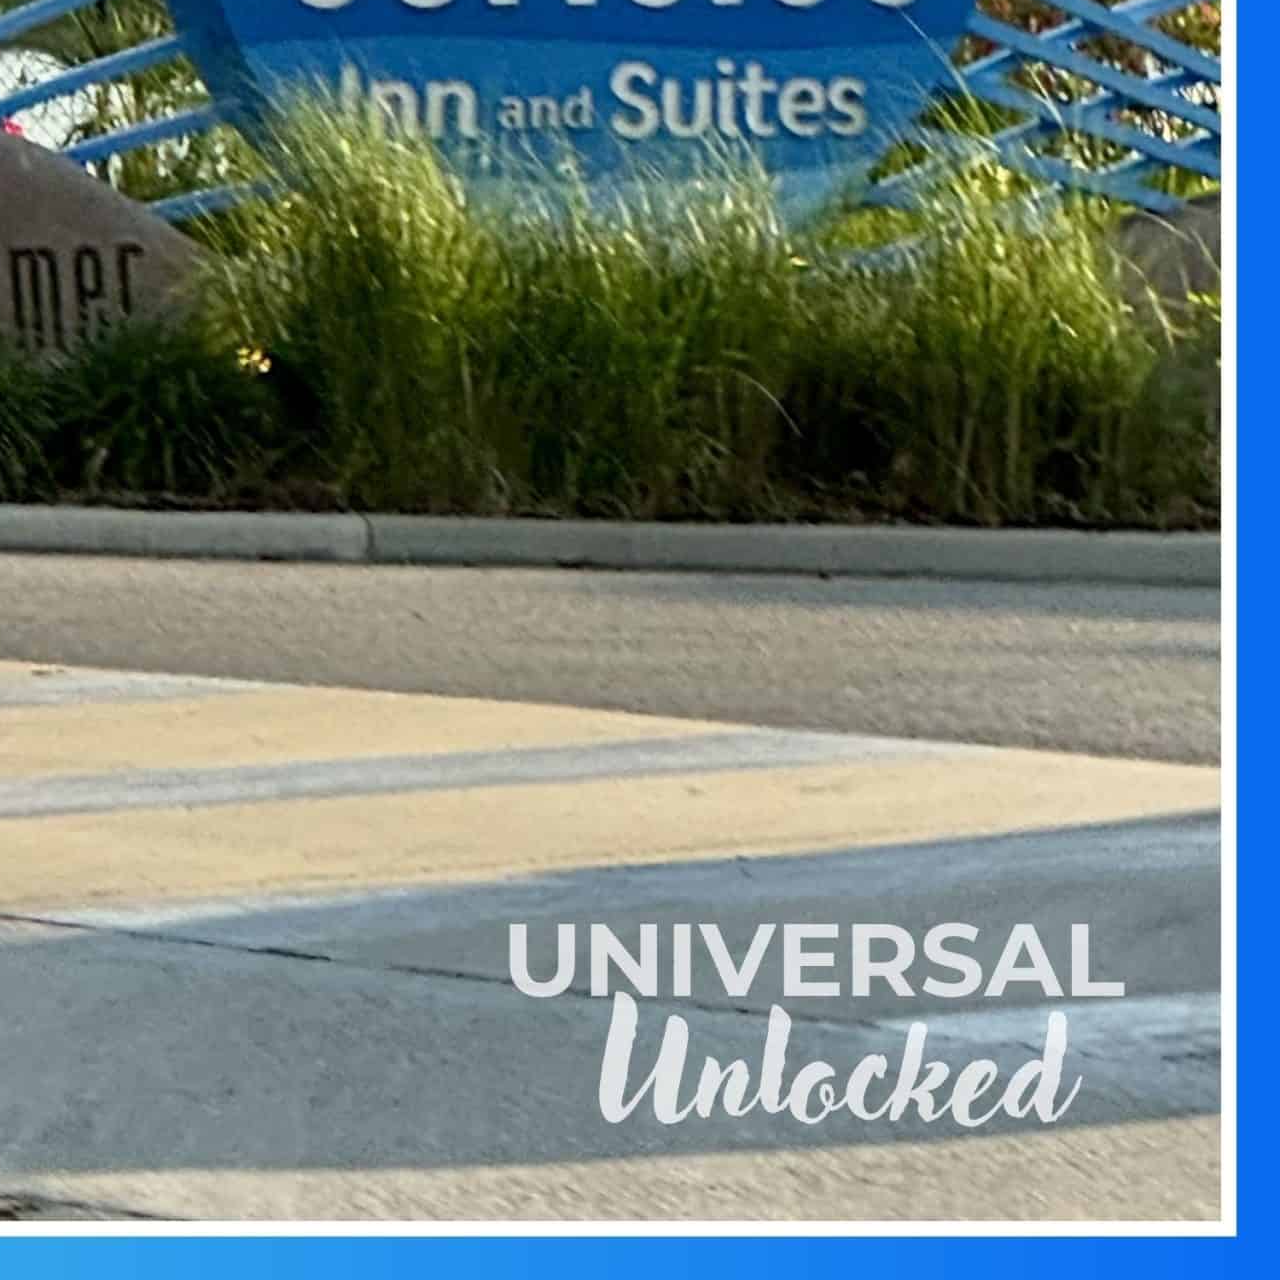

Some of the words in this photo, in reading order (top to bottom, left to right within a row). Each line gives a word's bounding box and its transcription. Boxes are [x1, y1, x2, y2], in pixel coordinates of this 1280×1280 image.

[338, 64, 478, 138] Inn
[497, 86, 594, 130] and
[609, 58, 868, 140] Suites
